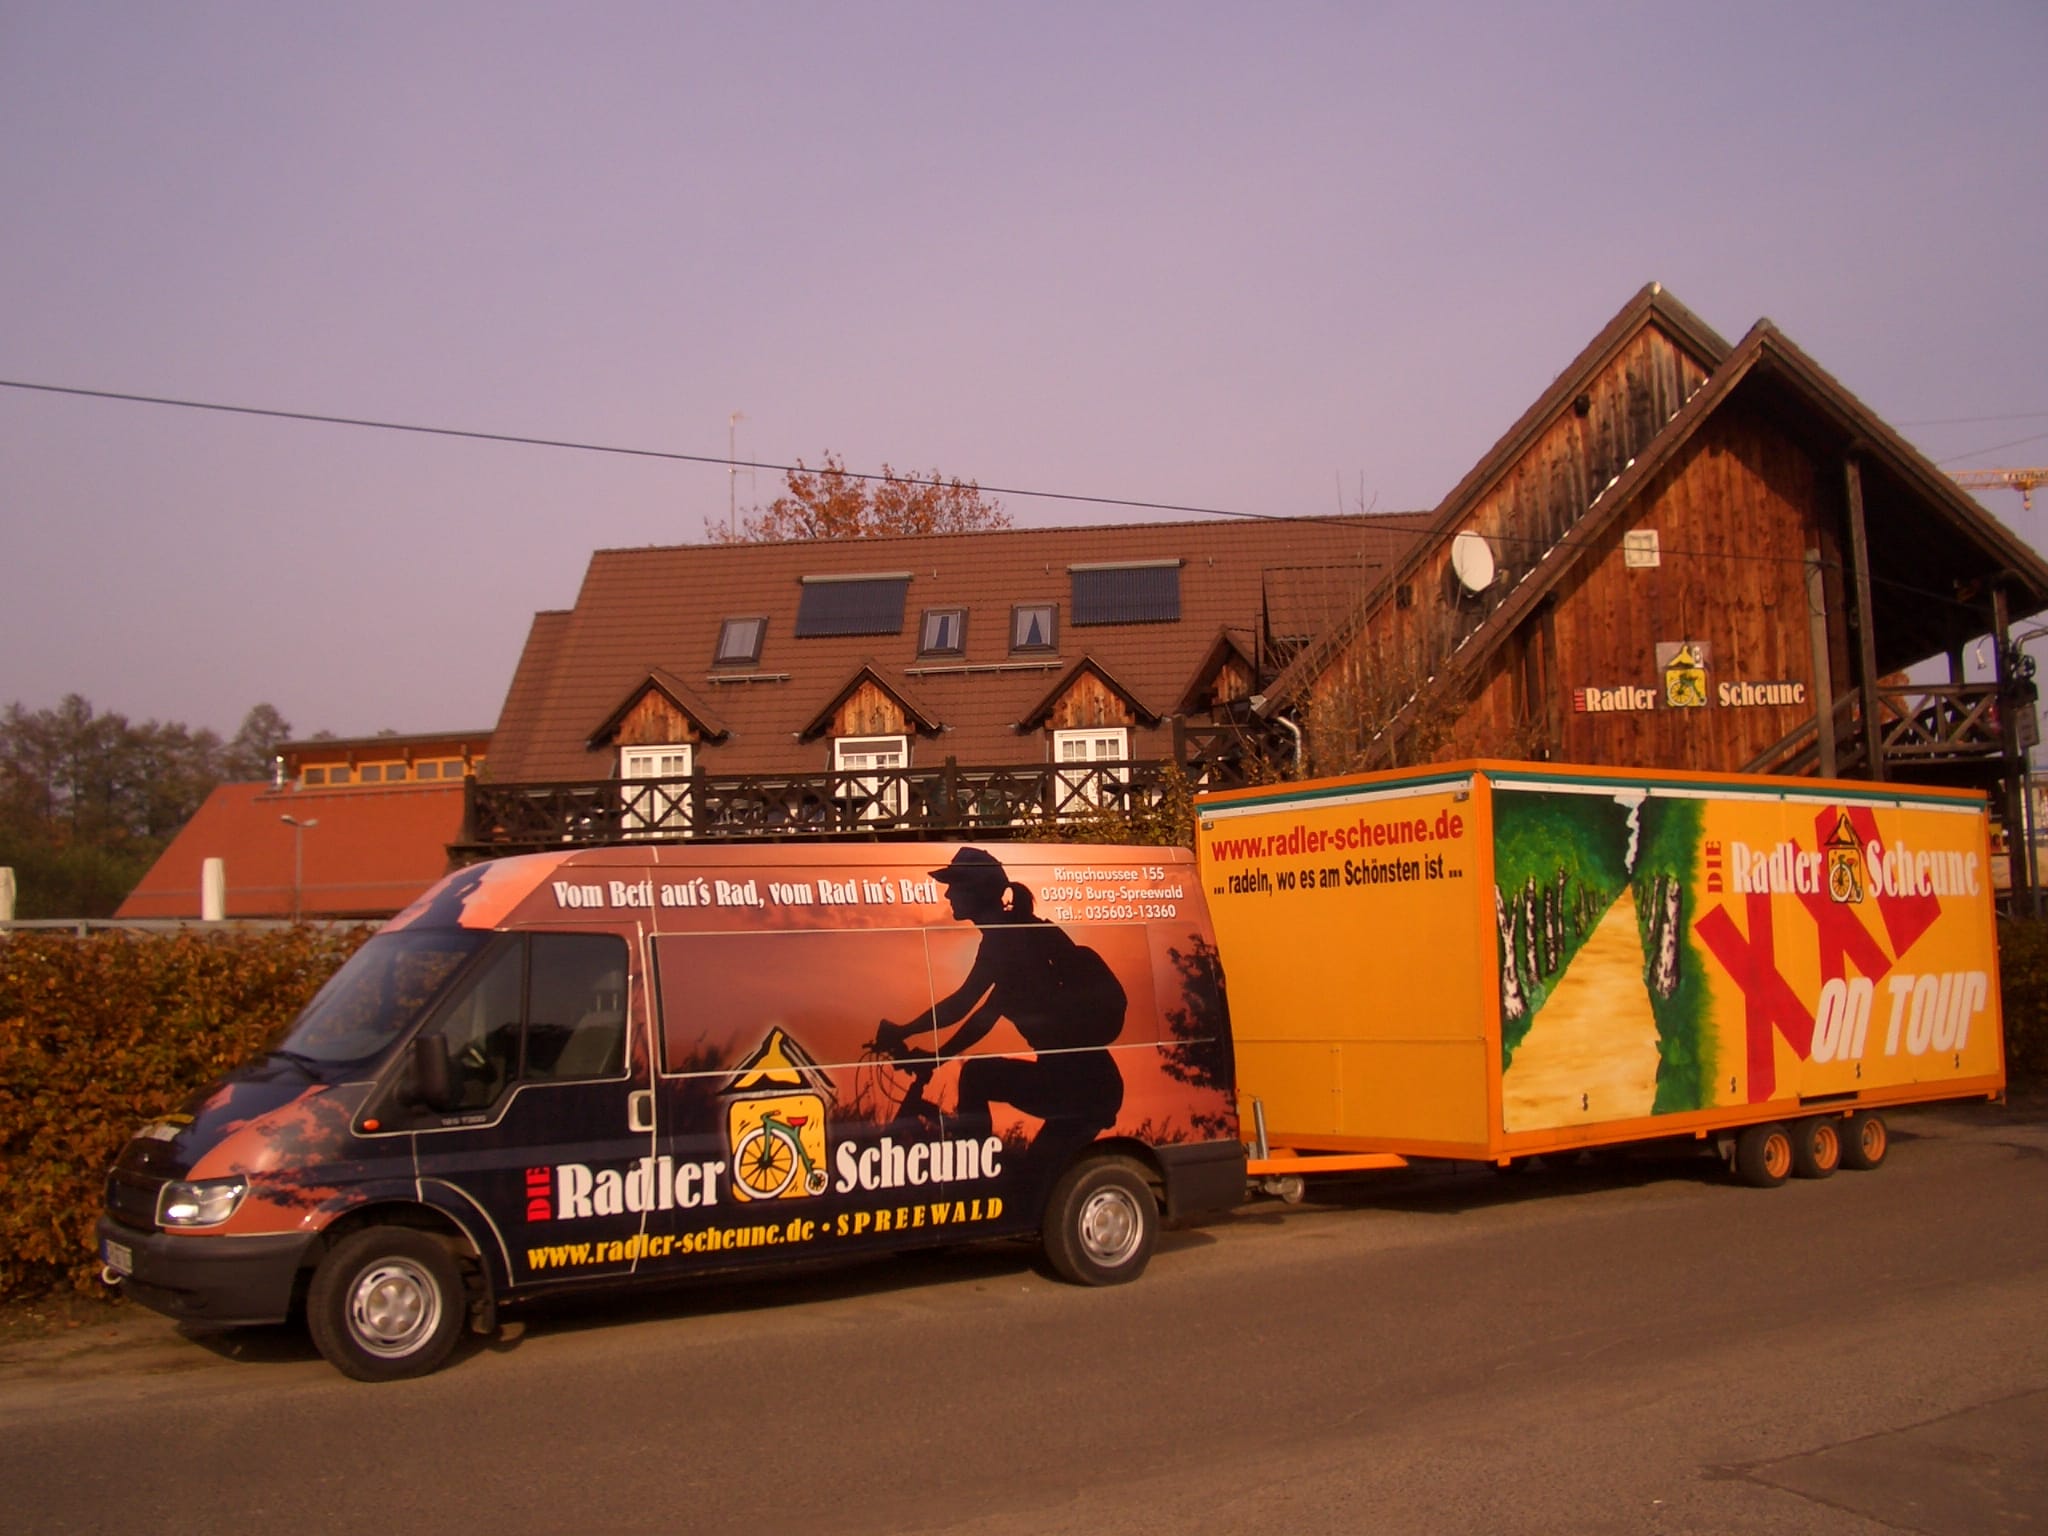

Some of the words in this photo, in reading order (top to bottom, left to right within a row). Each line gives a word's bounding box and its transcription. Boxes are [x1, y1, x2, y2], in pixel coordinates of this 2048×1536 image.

[1587, 686, 1657, 712] Radler
[1718, 682, 1805, 707] Scheune
[1212, 809, 1464, 862] www.radler-scheune.de
[1054, 867, 1139, 884] Ringchaussee
[1141, 867, 1165, 880] 155
[1228, 867, 1273, 897] radeln,
[1276, 871, 1296, 891] wo
[1300, 870, 1316, 889] es
[1319, 868, 1340, 888] am
[1344, 857, 1420, 886] Schönsten
[1424, 853, 1444, 879] ist
[1705, 840, 1723, 894] DIE
[1731, 841, 1823, 895] Radler
[1866, 839, 1980, 898] Scheune
[552, 881, 604, 908] Vom
[608, 880, 655, 907] Bett
[716, 879, 765, 908] Rad,
[769, 882, 814, 905] vom
[819, 878, 858, 905] Rad
[899, 878, 938, 904] Bett
[1041, 887, 1083, 900] 03096
[1086, 885, 1184, 902] Burg-Spreewald
[1056, 906, 1083, 920] Tel.:
[1085, 904, 1176, 919] 035603-13360
[526, 1166, 551, 1222] DIE
[556, 1157, 725, 1221] Radler
[835, 1135, 1003, 1194] Scheune
[527, 1217, 815, 1270] www.radler-scheune.de
[837, 1197, 1004, 1236] SPREEWALD
